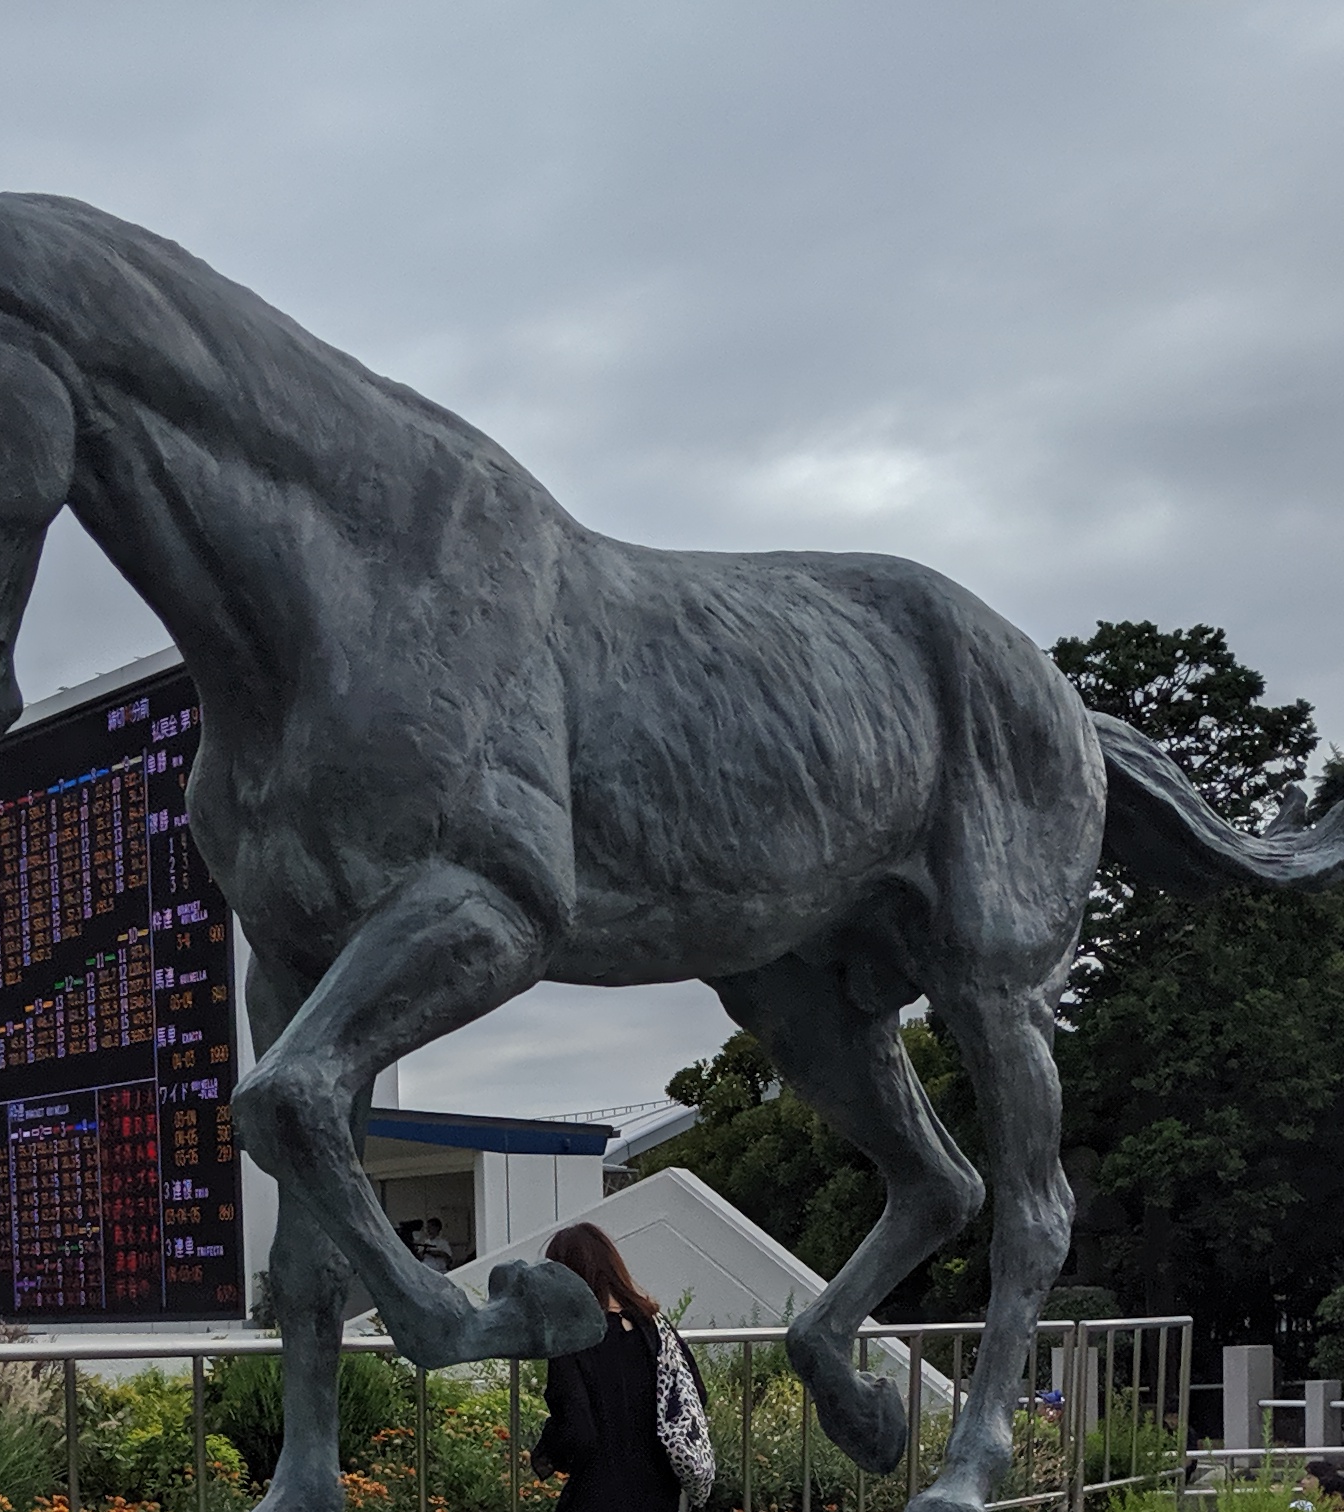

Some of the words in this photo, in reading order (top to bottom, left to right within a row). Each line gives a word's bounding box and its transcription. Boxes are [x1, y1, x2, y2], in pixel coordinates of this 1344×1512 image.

[152, 716, 177, 742] 払戻金
[147, 751, 166, 774] 単勝
[155, 968, 174, 990] 馬連
[157, 1025, 176, 1047] 馬単
[159, 1084, 188, 1104] ワイド
